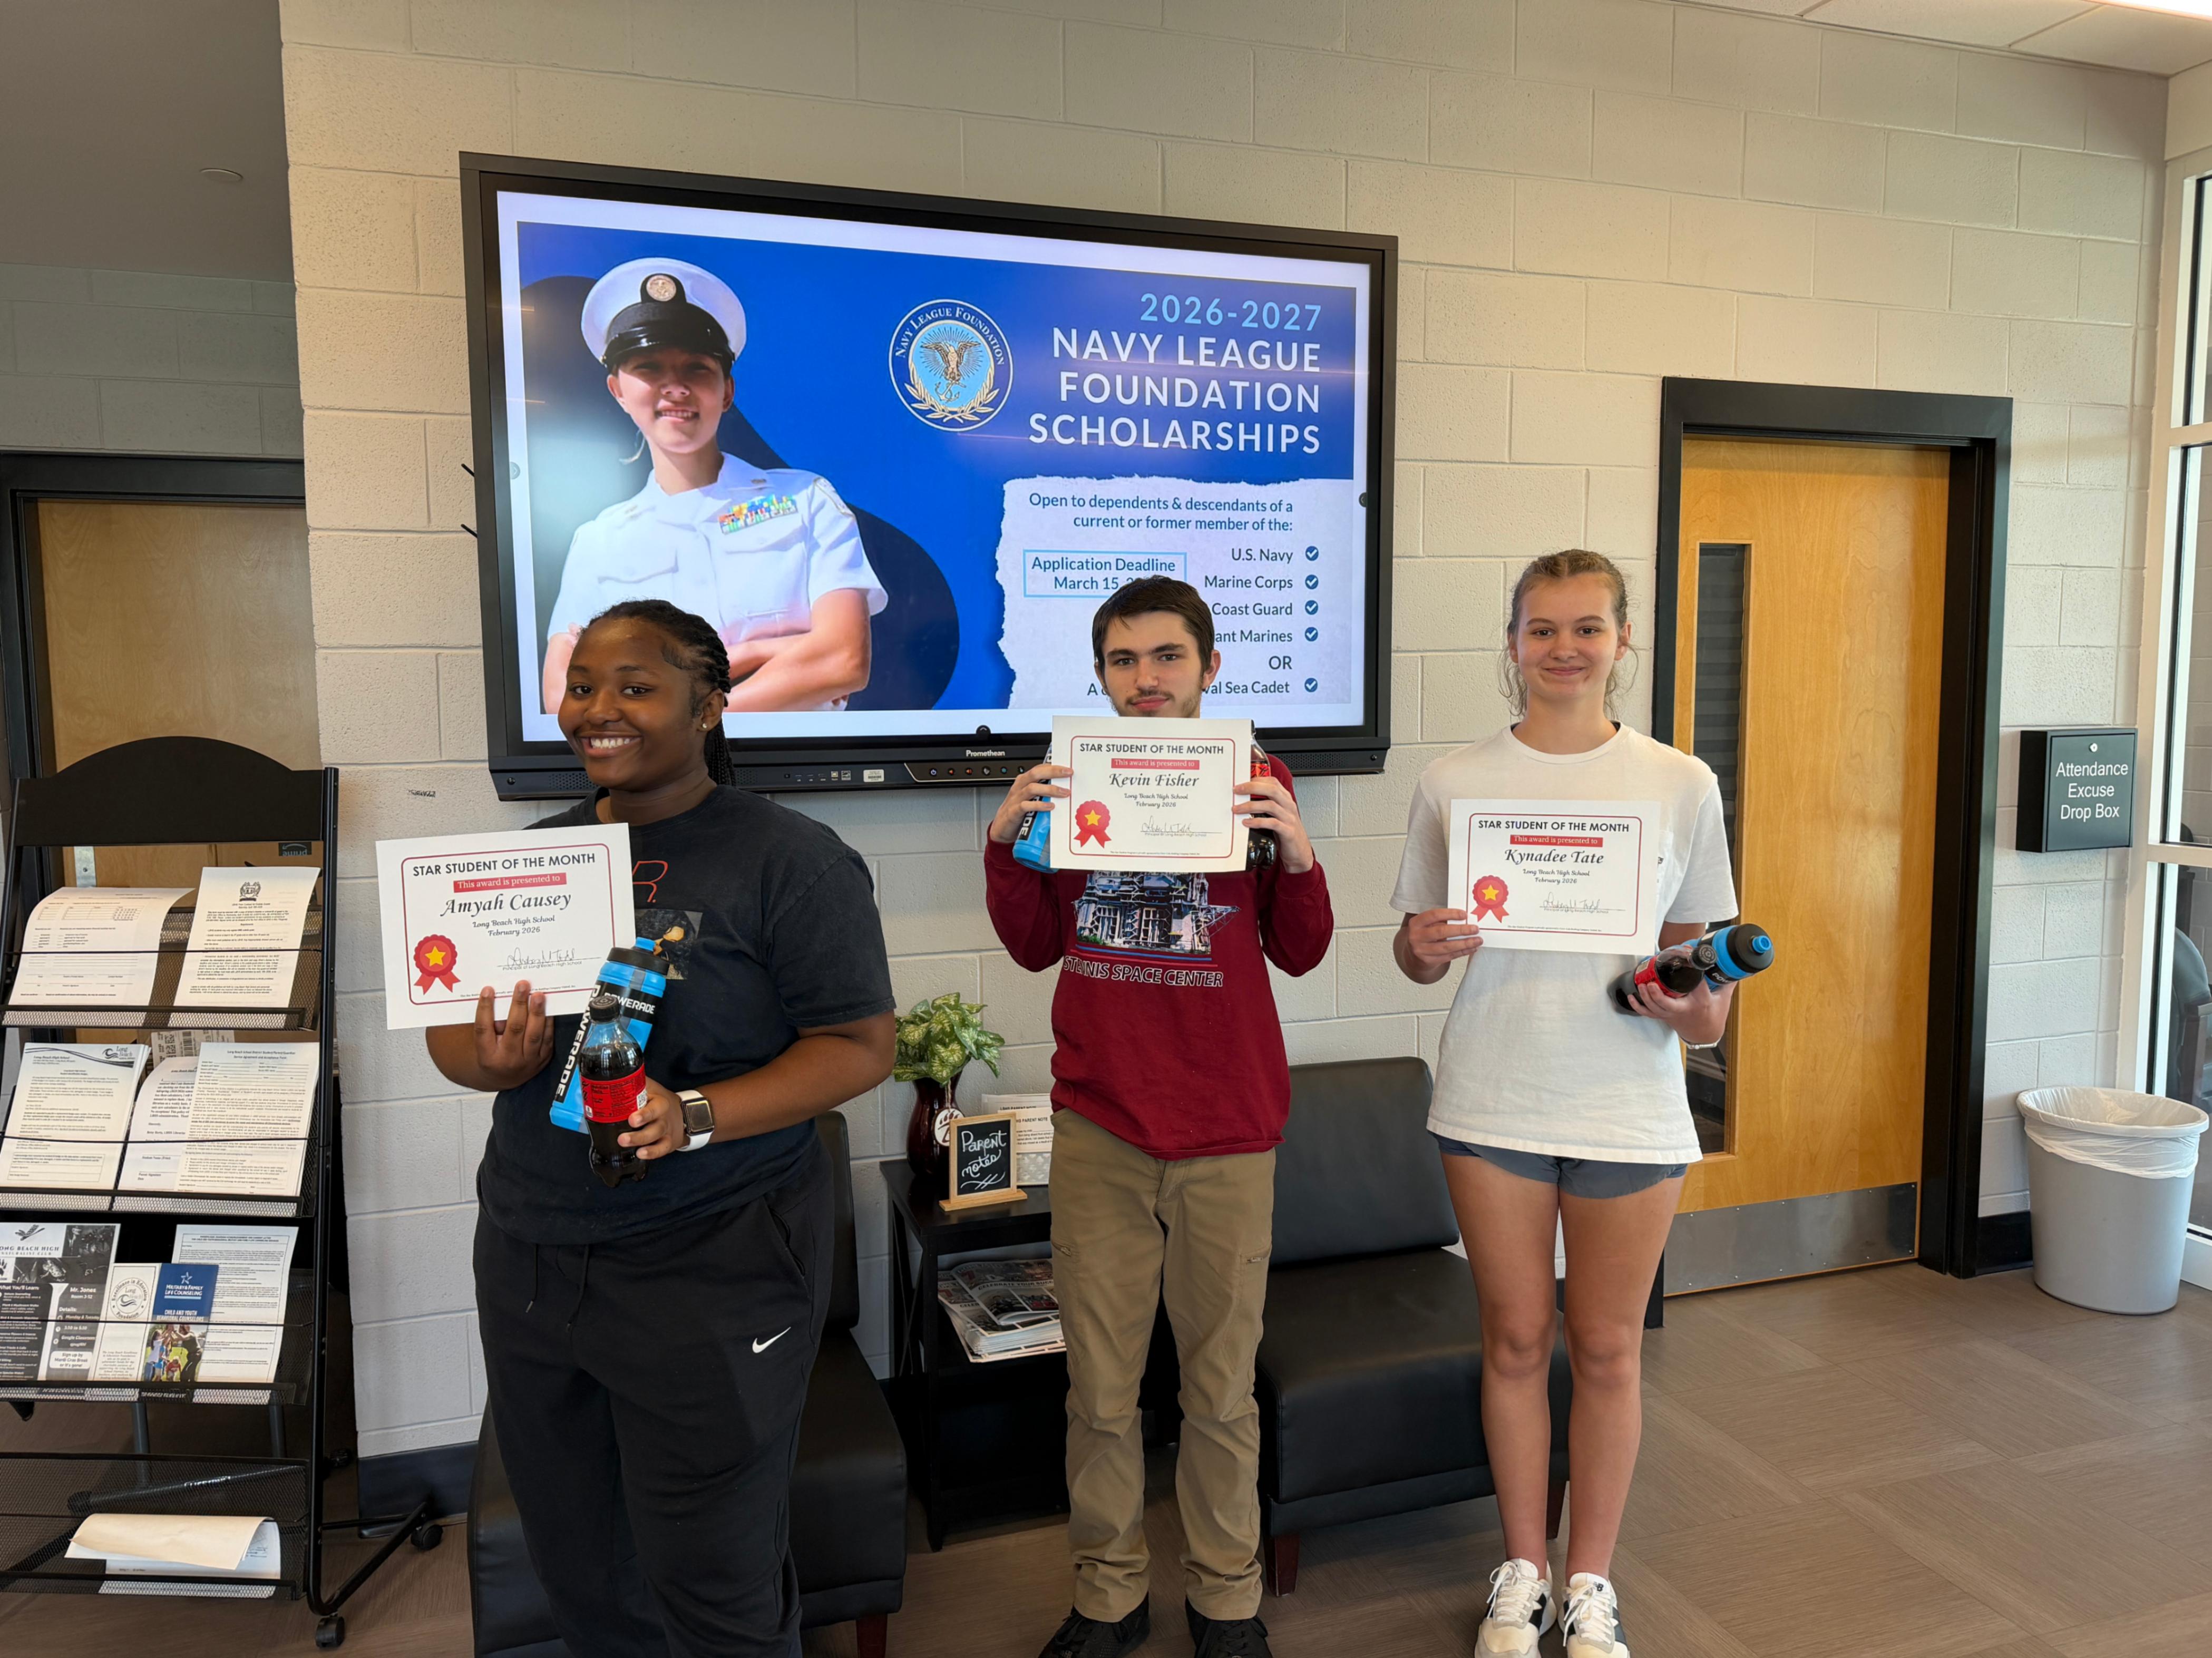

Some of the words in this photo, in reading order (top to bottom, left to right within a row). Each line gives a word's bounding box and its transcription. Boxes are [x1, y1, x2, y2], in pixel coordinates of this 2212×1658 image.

[1140, 293, 1321, 331] 2026-2027
[895, 328, 913, 358] NAVY
[909, 307, 952, 330] LEAGUE
[955, 307, 1005, 365] FOUNDATION
[1053, 327, 1163, 364] NAVY
[1178, 335, 1321, 372] LEAGUE
[1060, 371, 1319, 413] FOUNDATION
[1029, 413, 1320, 454] SCHOLARSHIPS
[1029, 493, 1068, 510] Open
[1071, 495, 1086, 508] to
[1089, 495, 1169, 511] dependents
[1172, 498, 1182, 510] &
[1185, 497, 1268, 512] descendants
[1270, 500, 1283, 512] of
[1285, 503, 1293, 512] a
[1073, 516, 1125, 528] current
[1127, 518, 1143, 528] or
[1145, 516, 1192, 529] former
[1194, 518, 1250, 530] member
[1252, 518, 1266, 530] of
[1268, 519, 1293, 531] the:
[1231, 549, 1256, 561] U.S.
[1259, 549, 1293, 564] Navy
[1031, 557, 1112, 572] Application
[1115, 558, 1176, 571] Deadline
[1054, 577, 1098, 589] March
[1204, 575, 1252, 588] Marine
[1254, 576, 1293, 591] Corps
[1212, 603, 1250, 616] Coast
[1252, 603, 1293, 616] Guard
[1240, 630, 1293, 642] Marines
[1268, 656, 1292, 670] OR
[1087, 684, 1098, 696] A
[1225, 682, 1248, 694] Sea
[1251, 681, 1290, 694] Cadet
[1080, 743, 1103, 752] STAR
[1106, 744, 1147, 753] STUDENT
[1150, 745, 1164, 754] OF
[1167, 745, 1184, 754] THE
[1187, 745, 1224, 754] MONTH
[2055, 761, 2128, 777] Attendance
[1109, 773, 1150, 787] Kevin
[1155, 773, 1200, 787] Fisher
[2068, 783, 2114, 798] Excuse
[2060, 804, 2091, 822] Drop
[2095, 803, 2120, 818] Box
[1478, 820, 1502, 829] STAR
[1505, 821, 1548, 830] STUDENT
[1551, 822, 1566, 831] OF
[1568, 822, 1586, 831] THE
[1589, 823, 1629, 832] MONTH
[413, 865, 441, 876] STAR
[445, 860, 498, 874] STUDENT
[501, 859, 519, 869] OF
[522, 857, 544, 867] THE
[548, 853, 596, 865] MONTH
[1504, 849, 1567, 865] Kynadee
[1571, 851, 1604, 864] Tate
[457, 881, 475, 889] This
[476, 878, 501, 887] award
[511, 875, 551, 886] presented
[440, 894, 504, 917] Amyah
[510, 893, 571, 910] Causey
[491, 918, 512, 926] Beach
[513, 916, 531, 926] High
[532, 915, 555, 923] School
[488, 928, 520, 937] February
[1112, 964, 1162, 984] SPACE
[1164, 970, 1223, 987] CENTER
[556, 984, 601, 1097] PWERADE
[961, 1149, 1001, 1178] notes
[978, 1282, 1015, 1291] CELEBRATE
